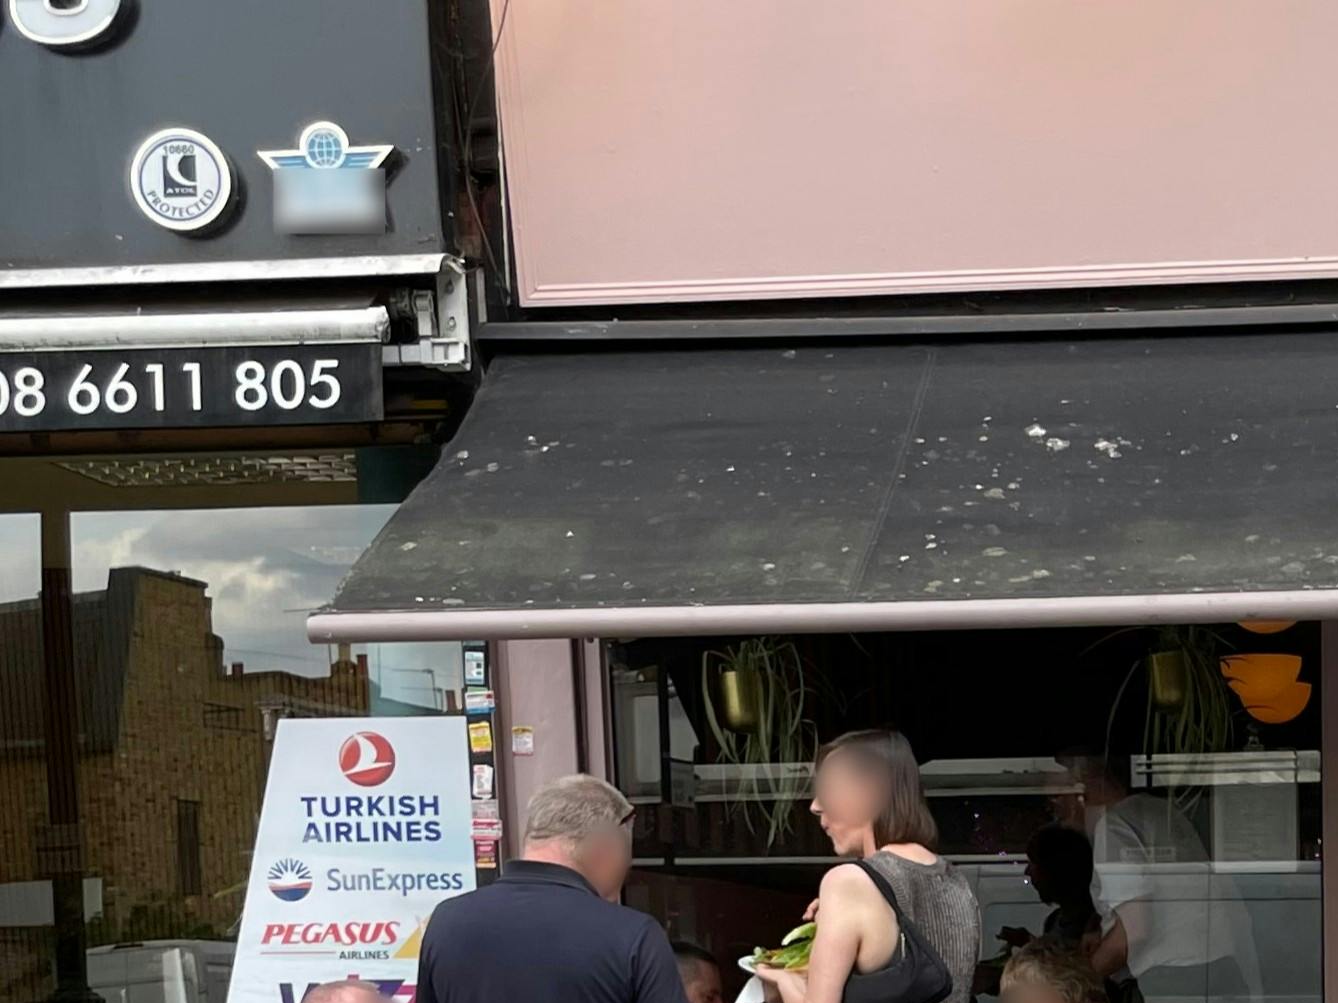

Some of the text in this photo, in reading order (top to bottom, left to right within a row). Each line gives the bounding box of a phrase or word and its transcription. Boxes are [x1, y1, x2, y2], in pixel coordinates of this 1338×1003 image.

[147, 189, 214, 217] PROTECTED
[0, 359, 341, 416] 8 6611 805
[301, 795, 440, 818] TURKISH
[302, 820, 442, 843] AIRLINES
[327, 868, 463, 896] SunExpress
[260, 921, 400, 946] PEGASUS
[339, 950, 390, 960] AIRLINES
